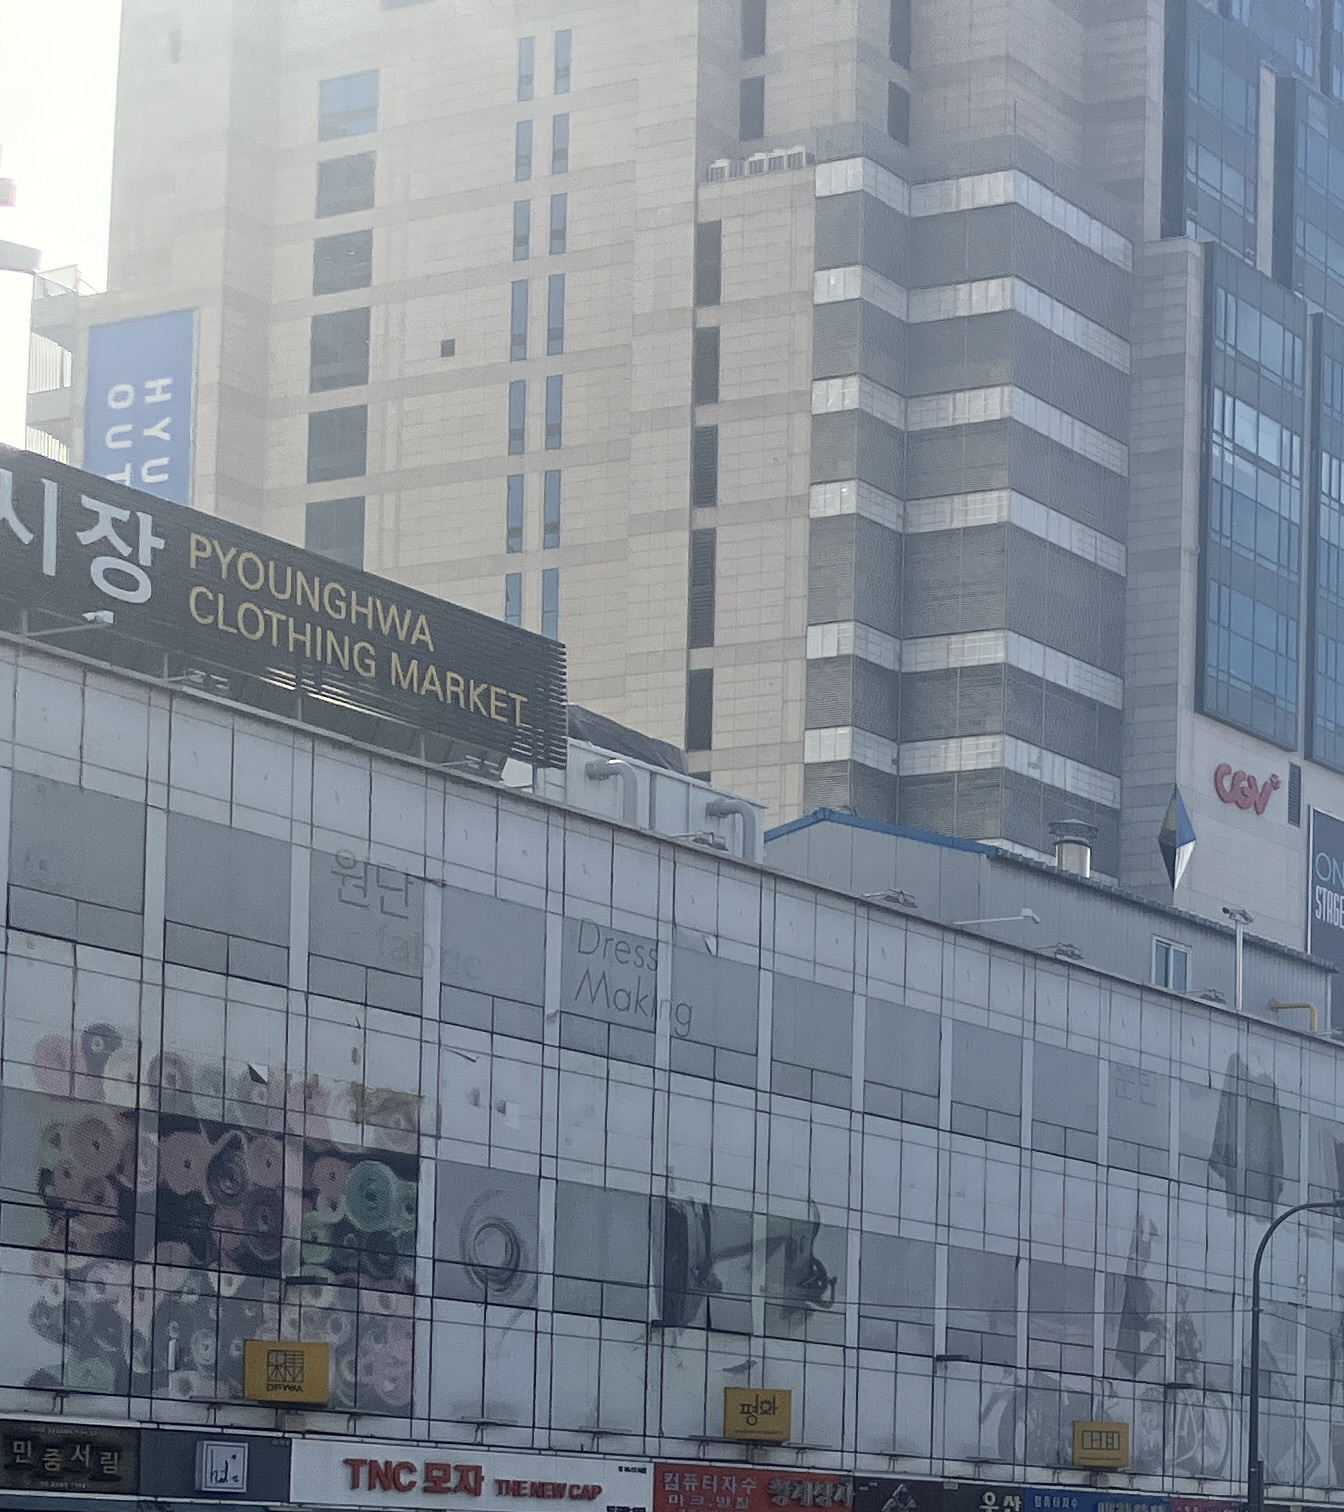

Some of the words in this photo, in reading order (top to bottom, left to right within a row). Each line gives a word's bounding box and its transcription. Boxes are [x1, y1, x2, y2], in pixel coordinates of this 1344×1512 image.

[0, 468, 165, 604] 시장
[190, 532, 435, 652] PYOUNGHWA
[189, 586, 378, 679] CLOTHING
[391, 651, 529, 728] MARKET
[1214, 762, 1280, 815] CGV
[577, 918, 660, 973] Dress
[574, 966, 694, 1037] Making
[343, 1457, 417, 1492] TNC
[422, 1460, 485, 1497] 모자
[494, 1478, 528, 1498] THE
[530, 1480, 567, 1500] NEW
[568, 1483, 603, 1501] CAP
[664, 1471, 757, 1495] 컴퓨터자수
